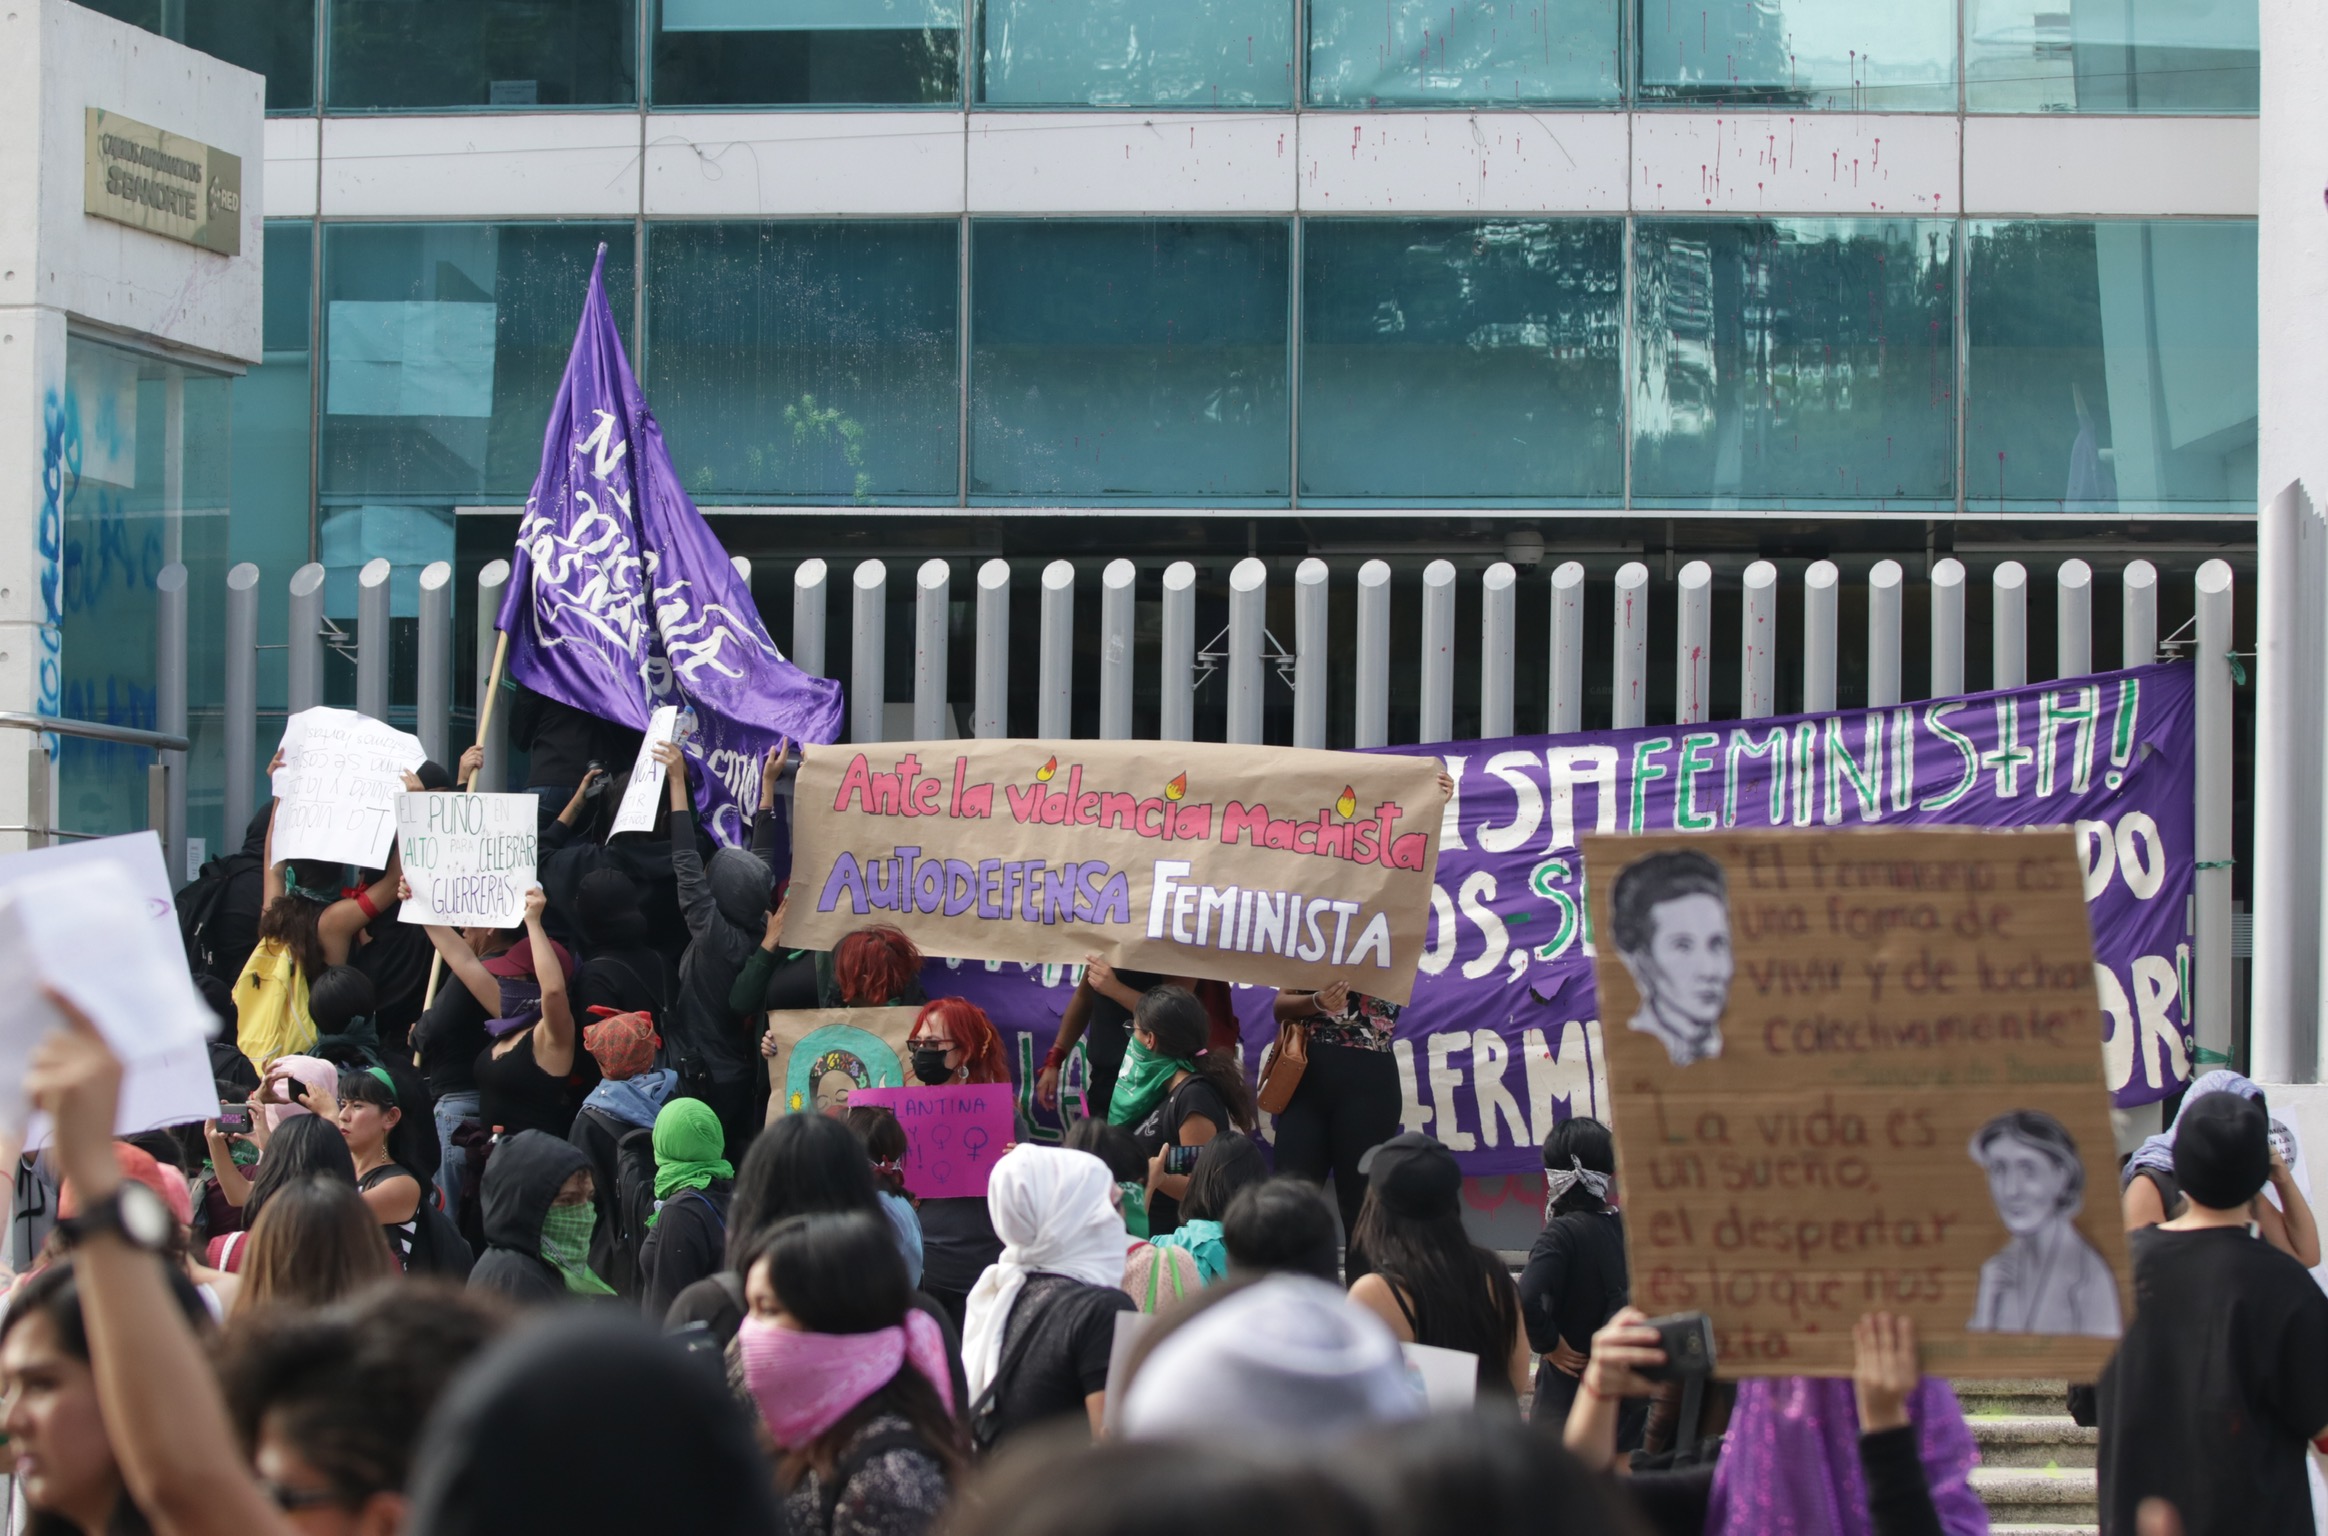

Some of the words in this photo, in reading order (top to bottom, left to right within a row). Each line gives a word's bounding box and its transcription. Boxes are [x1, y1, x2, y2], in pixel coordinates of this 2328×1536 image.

[122, 171, 197, 221] BANORTE
[221, 188, 239, 212] RED
[398, 795, 417, 823] EL
[429, 794, 483, 836] PUÑO
[494, 798, 510, 822] EN
[833, 753, 942, 818] Ante
[950, 756, 994, 819] la
[1005, 755, 1212, 841] violencia
[1220, 785, 1428, 872] Machista
[1439, 744, 1619, 857] ISA
[403, 836, 438, 869] ALTO
[450, 838, 474, 853] PARA
[478, 834, 537, 872] CELEBRAR
[2074, 810, 2166, 901] DO
[431, 874, 515, 917] GUERRERAS
[816, 845, 1131, 925] AUTODEFENSA
[1146, 859, 1392, 969] FEMINISTA
[1954, 893, 2014, 940] de
[1903, 947, 1957, 994] de
[2093, 943, 2194, 1091] OR!
[852, 1097, 986, 1119] LANTINA
[1756, 1090, 1869, 1148] vida
[1886, 1106, 1937, 1149] es
[1648, 1153, 1707, 1192] un
[1648, 1204, 1694, 1248] el
[1712, 1204, 1959, 1263] despertar
[1862, 1264, 1945, 1305] nos
